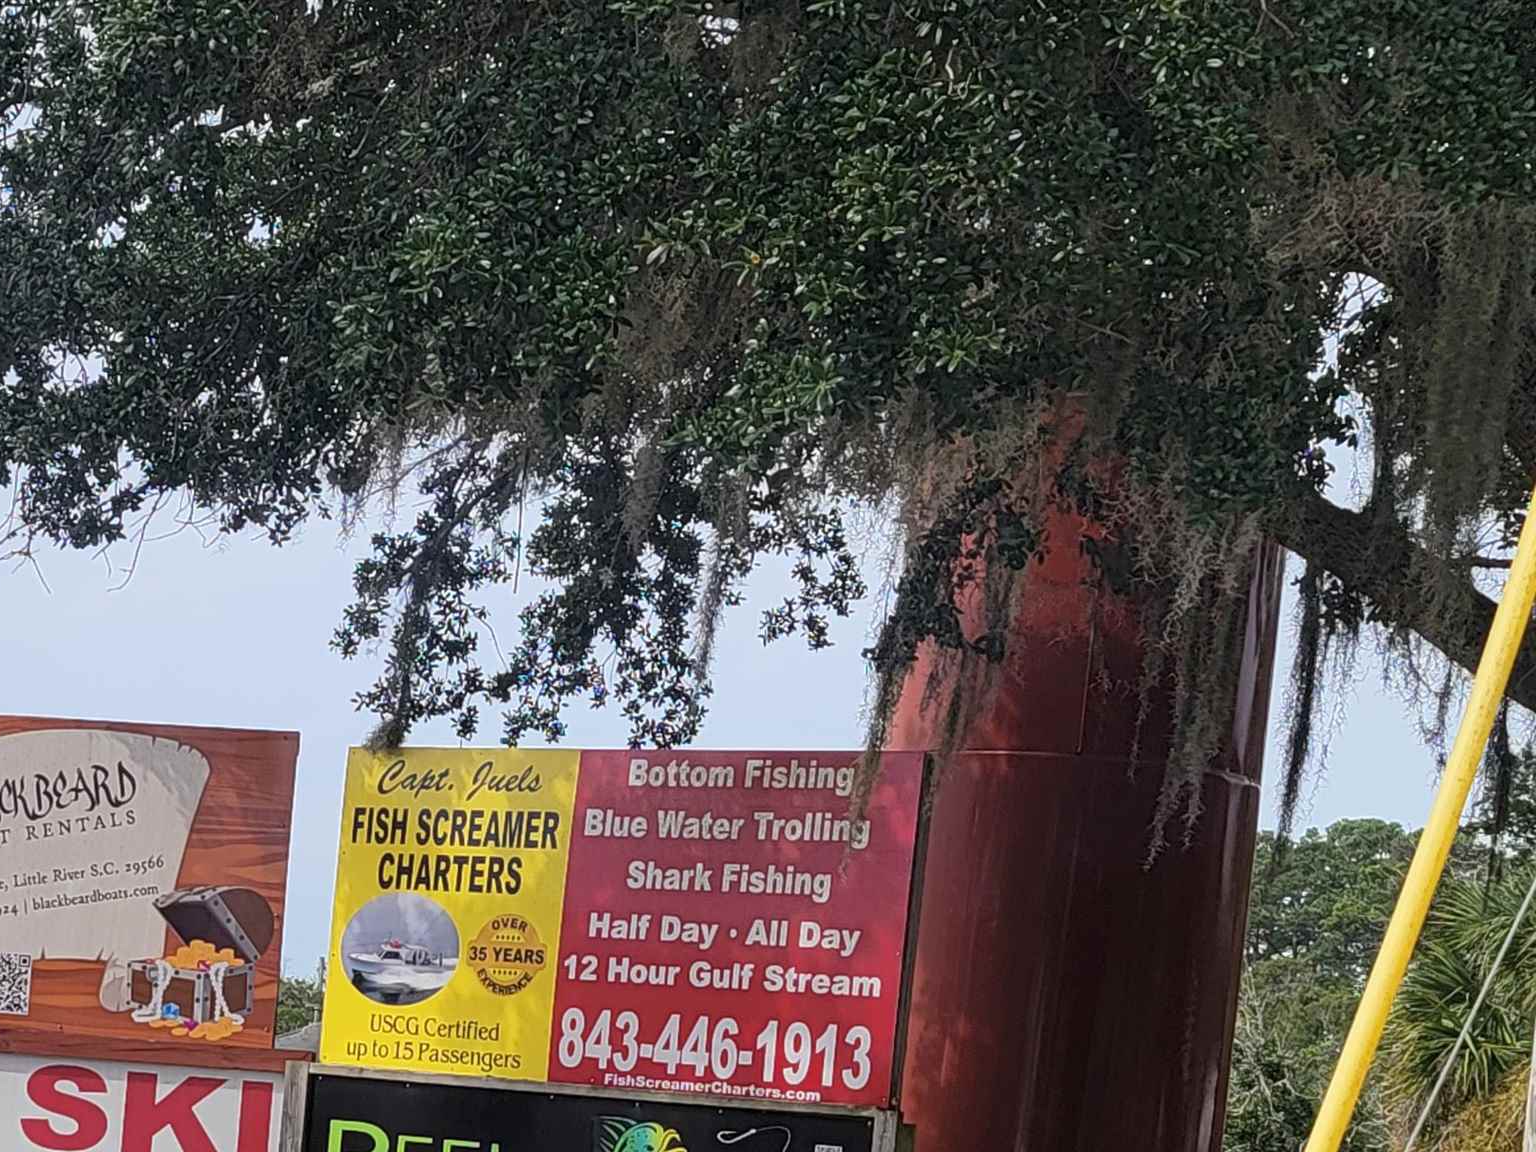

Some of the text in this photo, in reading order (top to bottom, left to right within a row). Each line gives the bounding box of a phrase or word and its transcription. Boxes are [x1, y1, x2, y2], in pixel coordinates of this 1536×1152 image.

[377, 760, 543, 802] Capt. Juels
[628, 759, 855, 796] Bottom Fishing
[26, 809, 137, 842] RENTALS
[352, 808, 560, 851] FISH SCREAMER
[584, 810, 870, 850] Blue Water Trolling
[14, 873, 48, 887] Little
[53, 869, 85, 882] River
[90, 862, 119, 877] S.C.
[126, 854, 165, 875] 29566
[378, 853, 522, 894] CHARTERS
[627, 860, 832, 903] Shark Fishing
[33, 884, 159, 911] blackbeardboats.com
[492, 917, 528, 932] OVER
[588, 912, 861, 956] Half Day All Day
[469, 946, 544, 964] 35 YEARS
[477, 968, 533, 995] EXPERIENCE
[564, 954, 881, 999] 12 Hour Gulf Stream
[370, 1013, 501, 1042] USCG Certified
[345, 1041, 522, 1073] up to 15 Passengers
[557, 1007, 873, 1091] 843-446-1913
[603, 1073, 821, 1103] FishScreamerCharters.com
